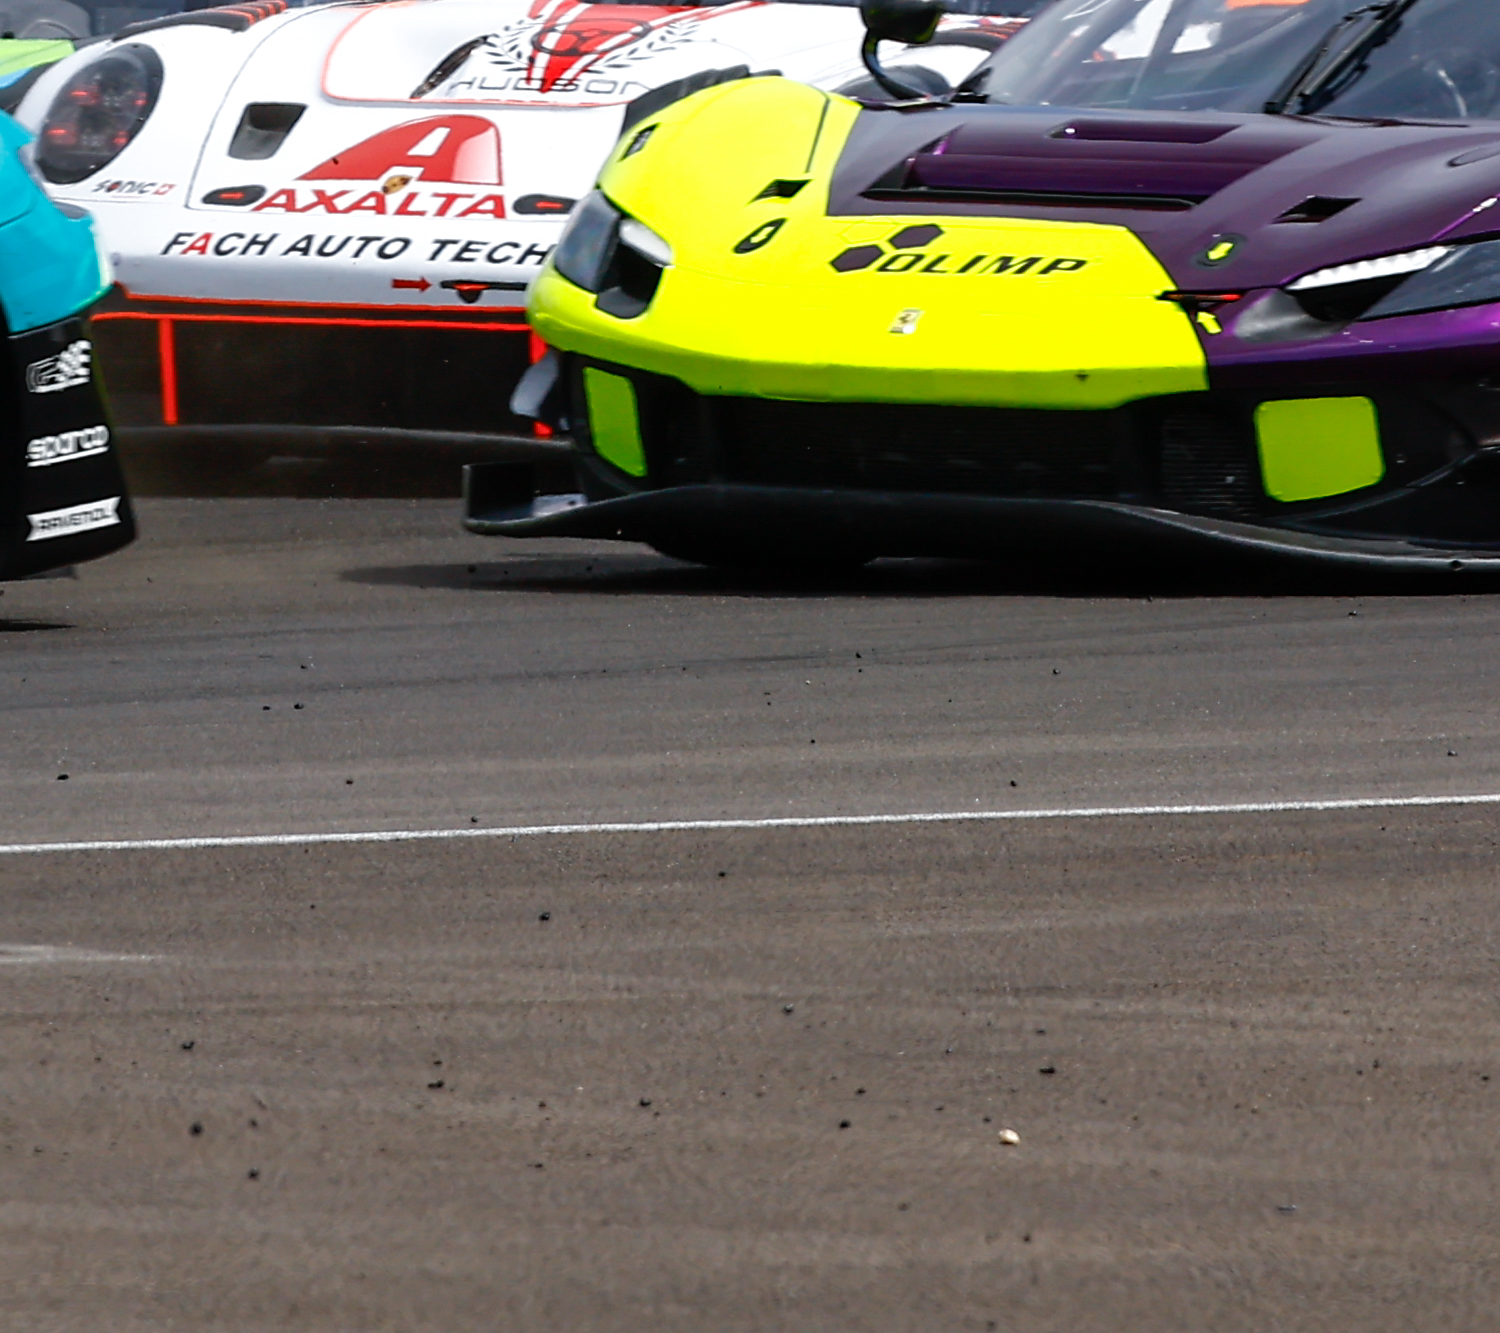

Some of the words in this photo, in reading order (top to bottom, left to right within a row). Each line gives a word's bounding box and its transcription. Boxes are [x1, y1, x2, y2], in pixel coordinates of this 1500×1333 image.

[251, 188, 508, 220] AXALTA
[160, 231, 272, 257] FACH
[281, 233, 413, 261] AUTO
[427, 238, 557, 266] TECH
[875, 253, 1088, 275] OLIMP
